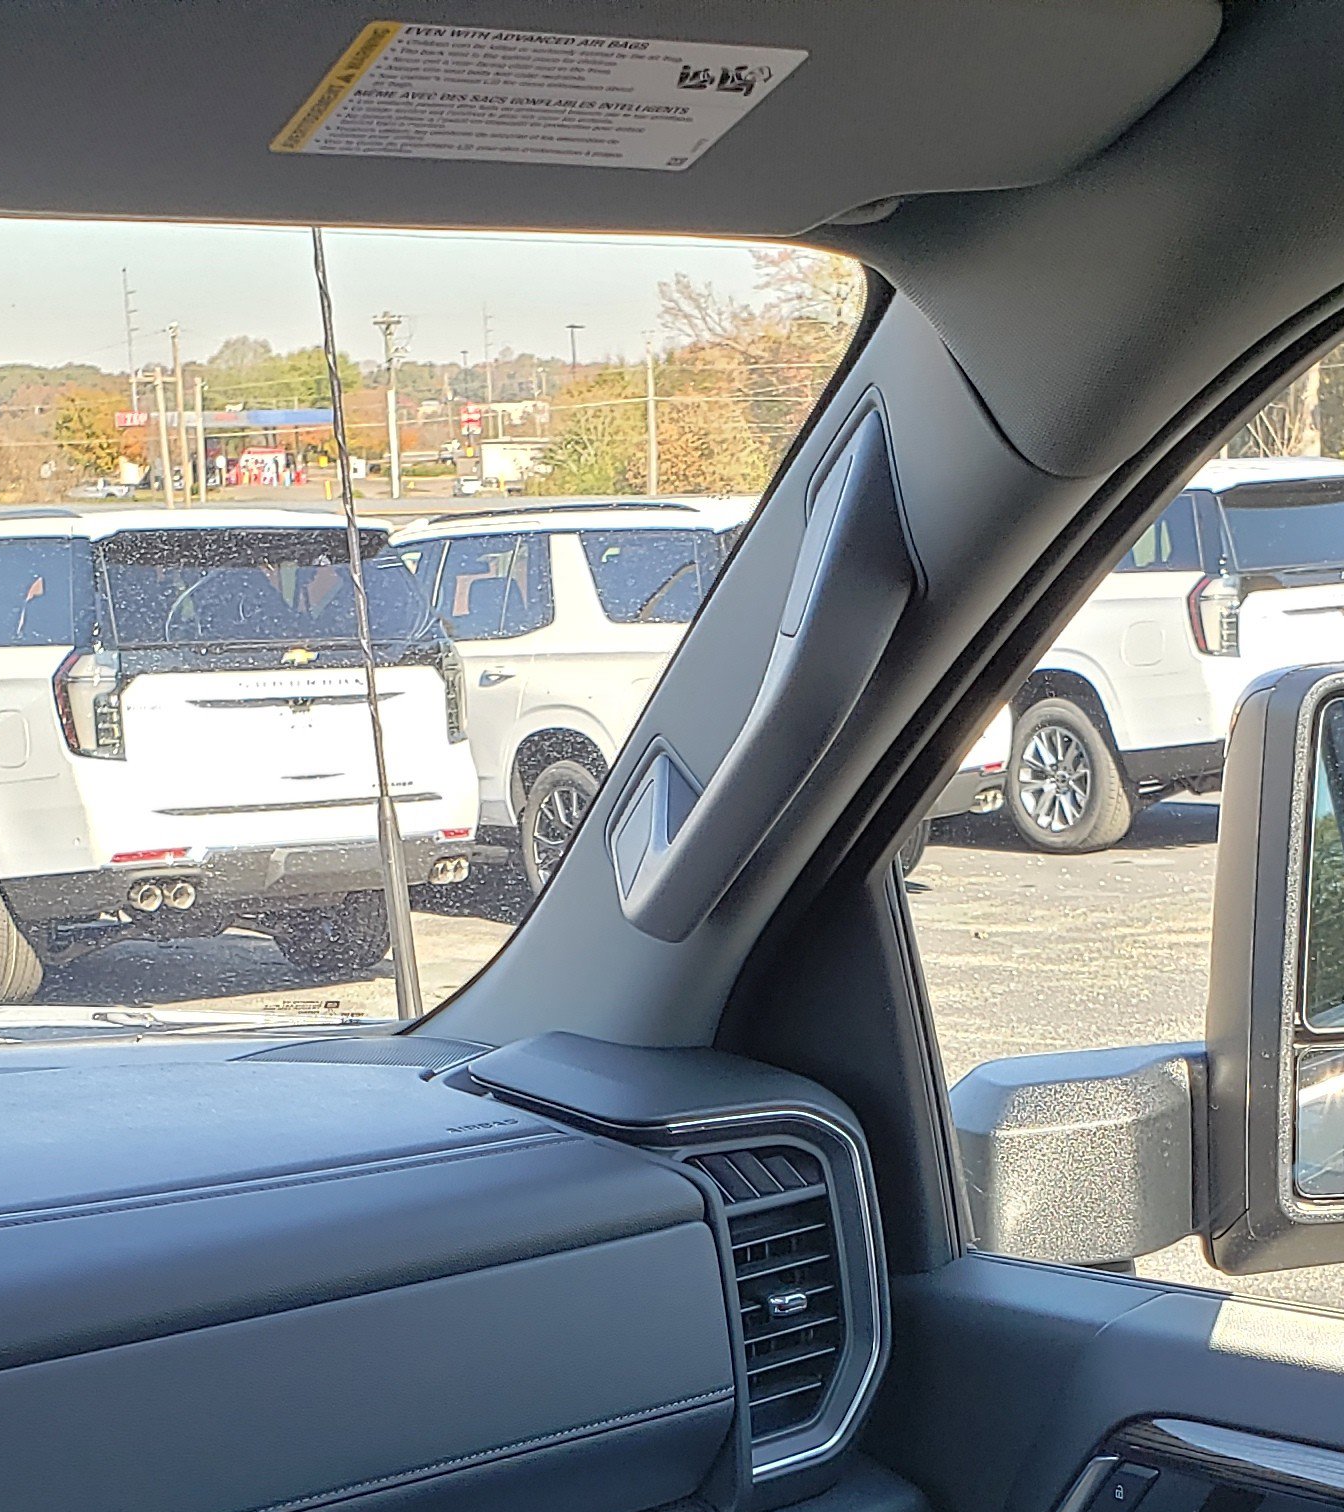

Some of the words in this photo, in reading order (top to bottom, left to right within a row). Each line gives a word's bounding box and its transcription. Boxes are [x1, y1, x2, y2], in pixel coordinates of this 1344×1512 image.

[406, 27, 446, 36] EVEN
[450, 29, 491, 40] WITH
[492, 33, 575, 44] ADVANCED
[577, 38, 606, 47] AIR
[608, 40, 649, 50] BAGS
